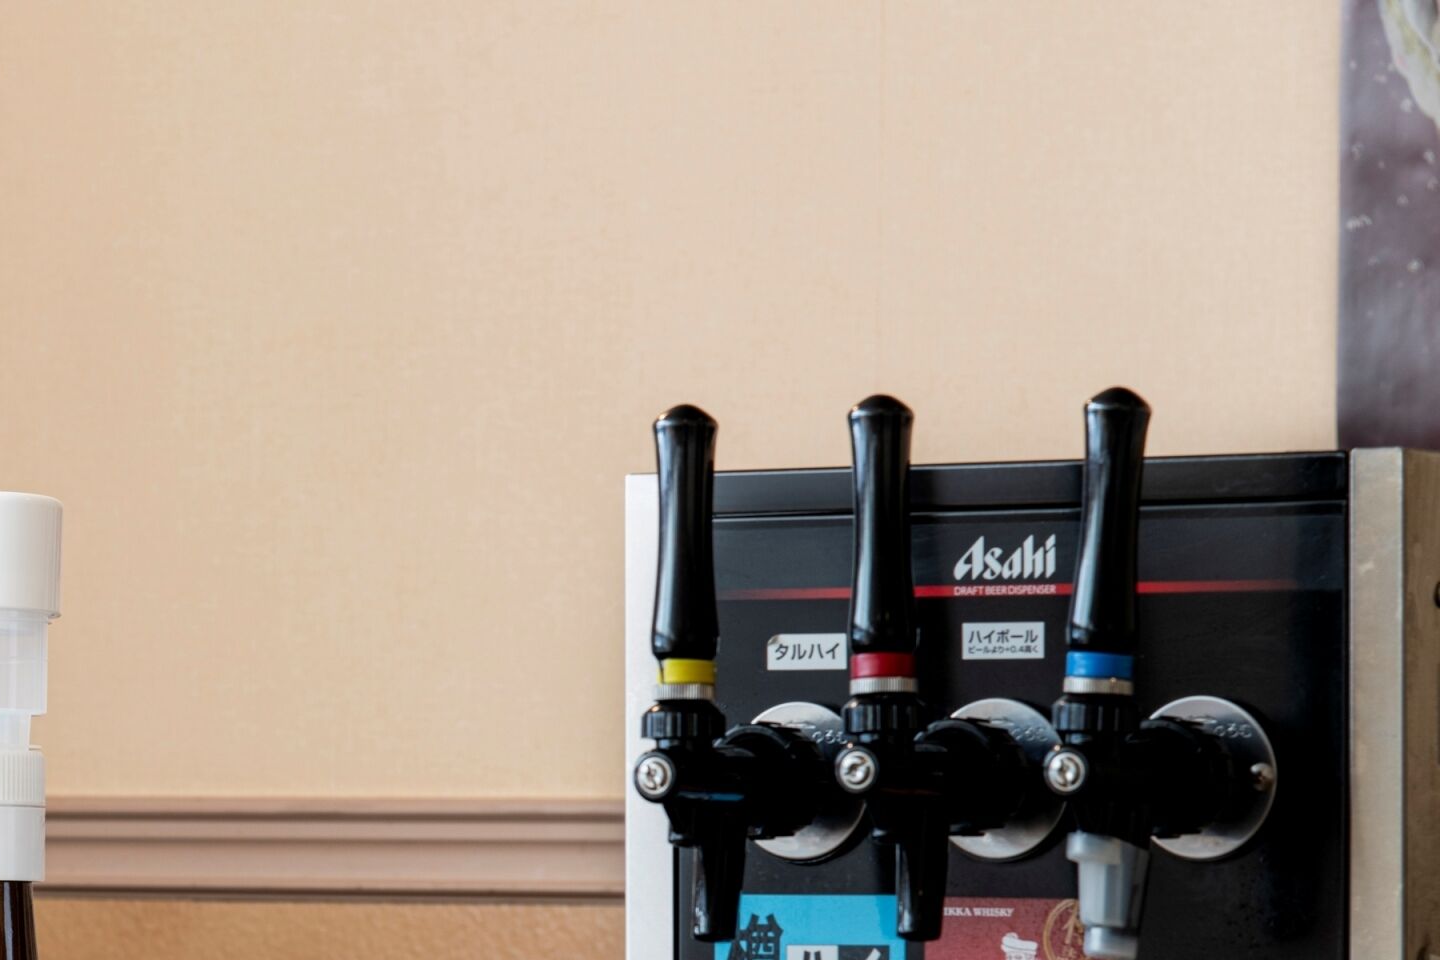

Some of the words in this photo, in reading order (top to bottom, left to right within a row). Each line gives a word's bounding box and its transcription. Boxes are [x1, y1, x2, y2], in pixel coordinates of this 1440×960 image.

[953, 534, 1056, 580] Asahi
[953, 586, 983, 596] DRAFT
[985, 586, 1008, 595] BEER
[1008, 584, 1057, 595] DISPENSER
[968, 629, 1038, 645] ハイボール
[774, 642, 840, 661] タルハイ
[944, 907, 972, 917] IKKA
[974, 907, 1014, 917] WHISKY
